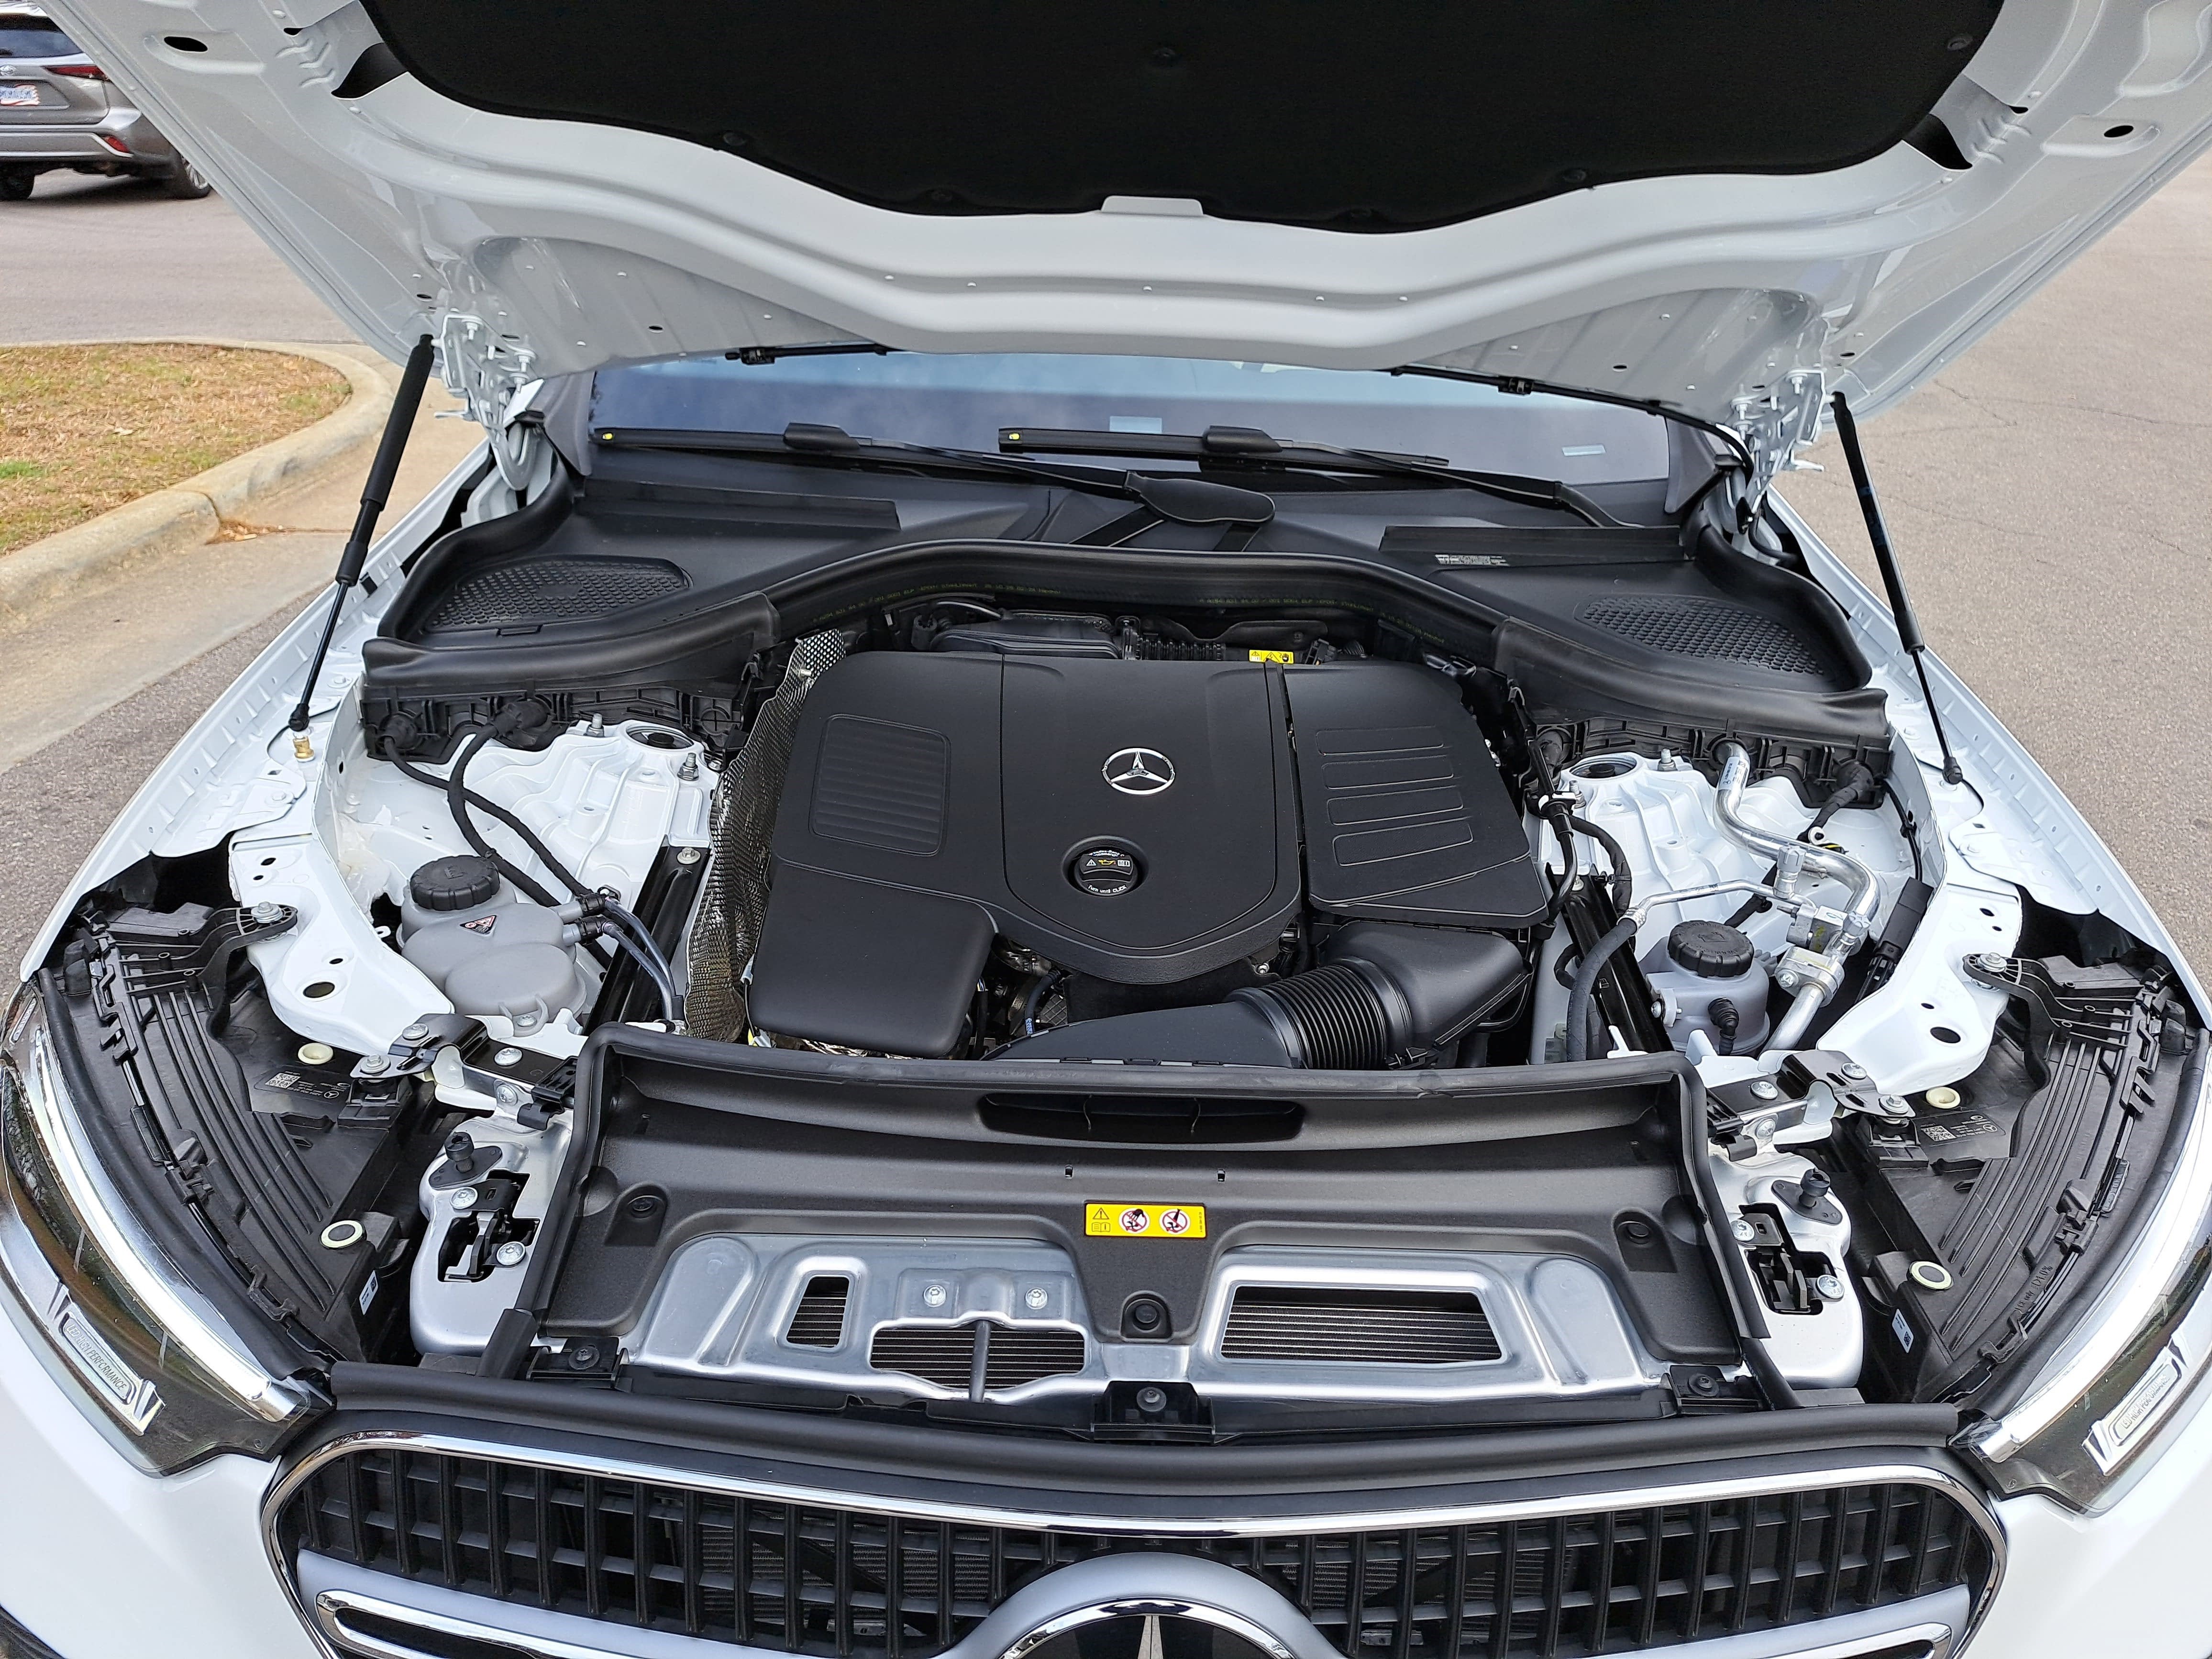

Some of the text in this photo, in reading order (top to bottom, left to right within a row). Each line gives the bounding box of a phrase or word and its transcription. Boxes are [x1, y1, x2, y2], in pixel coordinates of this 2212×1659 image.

[1088, 884, 1098, 892] Turn
[1112, 885, 1128, 893] CLICK
[66, 1324, 127, 1390] LED HIGH PERFORMANCE
[2120, 1416, 2133, 1429] LED
[2139, 1374, 2170, 1409] PERFORMANCE
